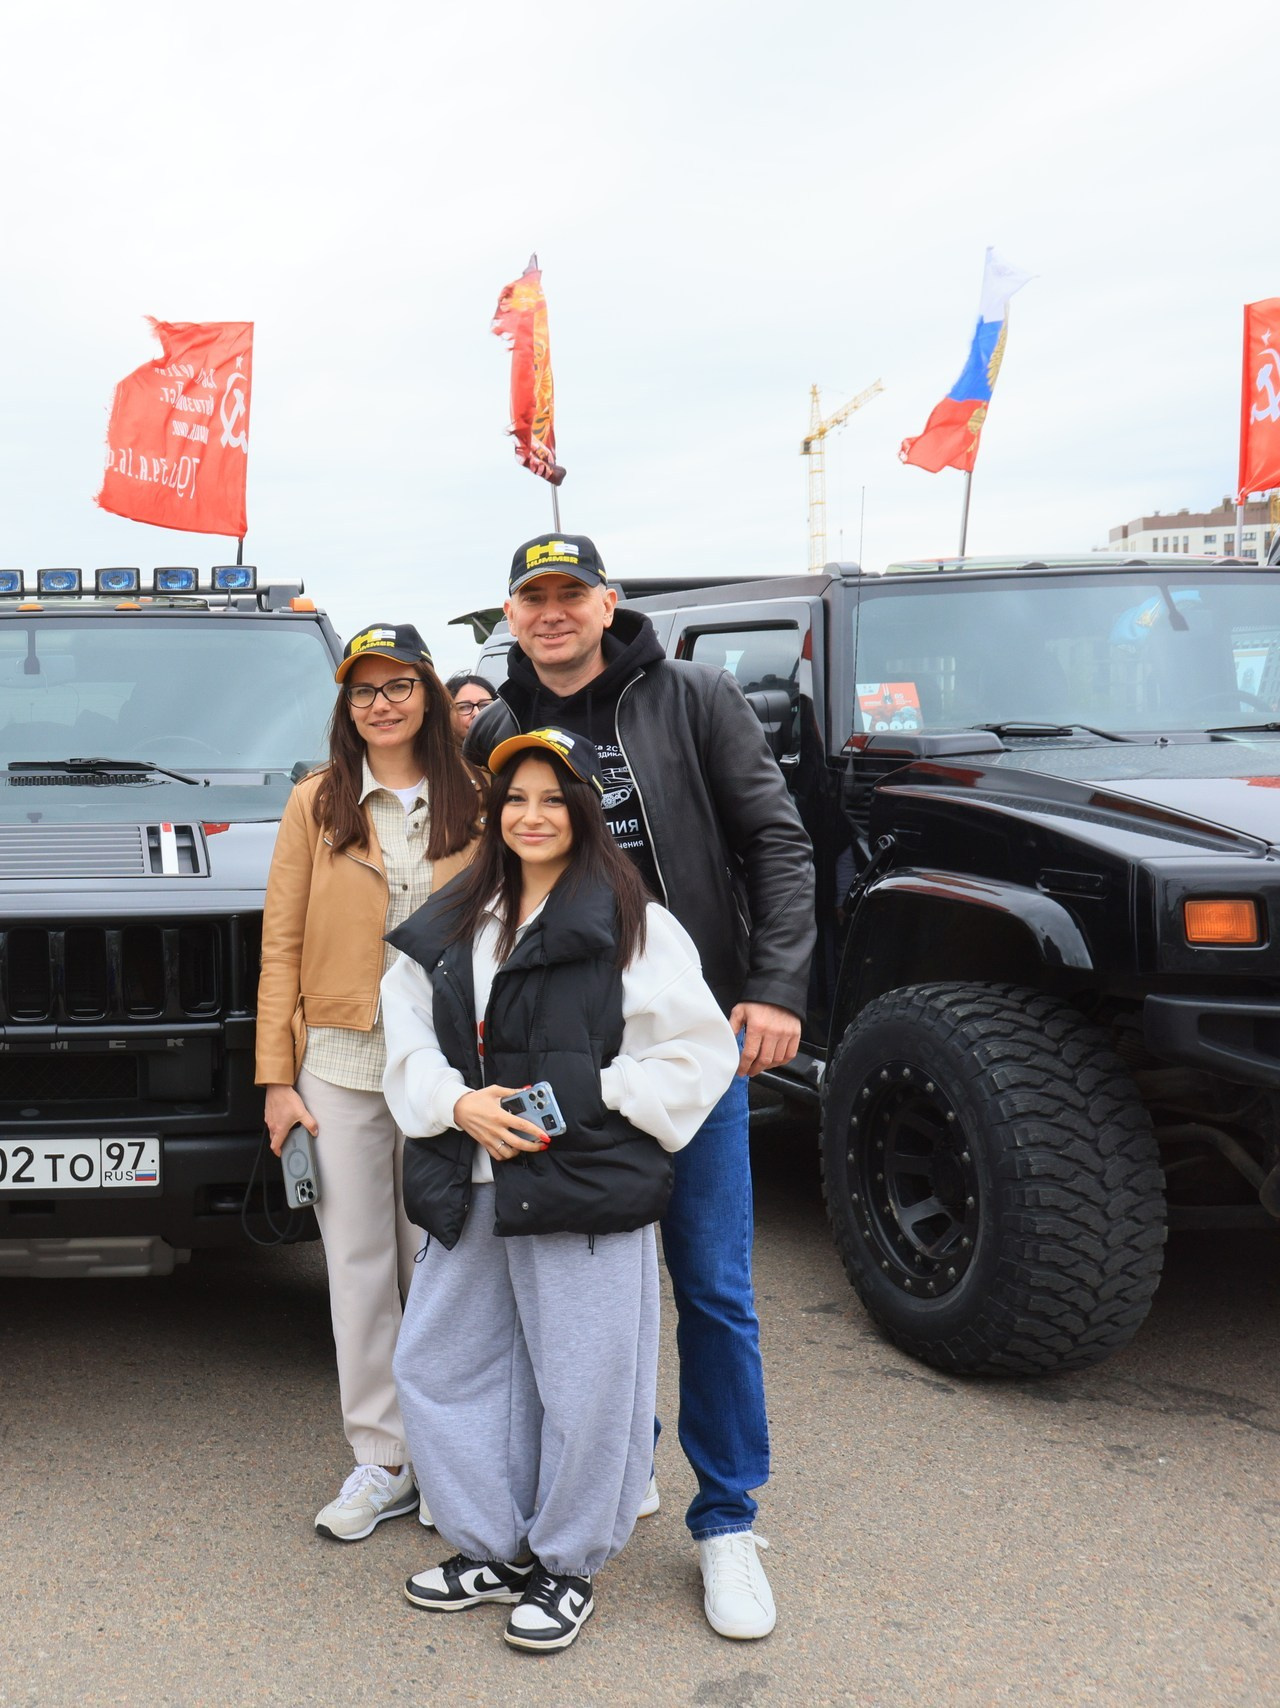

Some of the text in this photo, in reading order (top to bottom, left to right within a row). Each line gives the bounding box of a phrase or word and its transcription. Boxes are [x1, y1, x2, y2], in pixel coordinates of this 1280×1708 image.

[526, 556, 579, 569] HUMMER
[105, 1141, 146, 1171] 97
[104, 1171, 134, 1182] RUS
